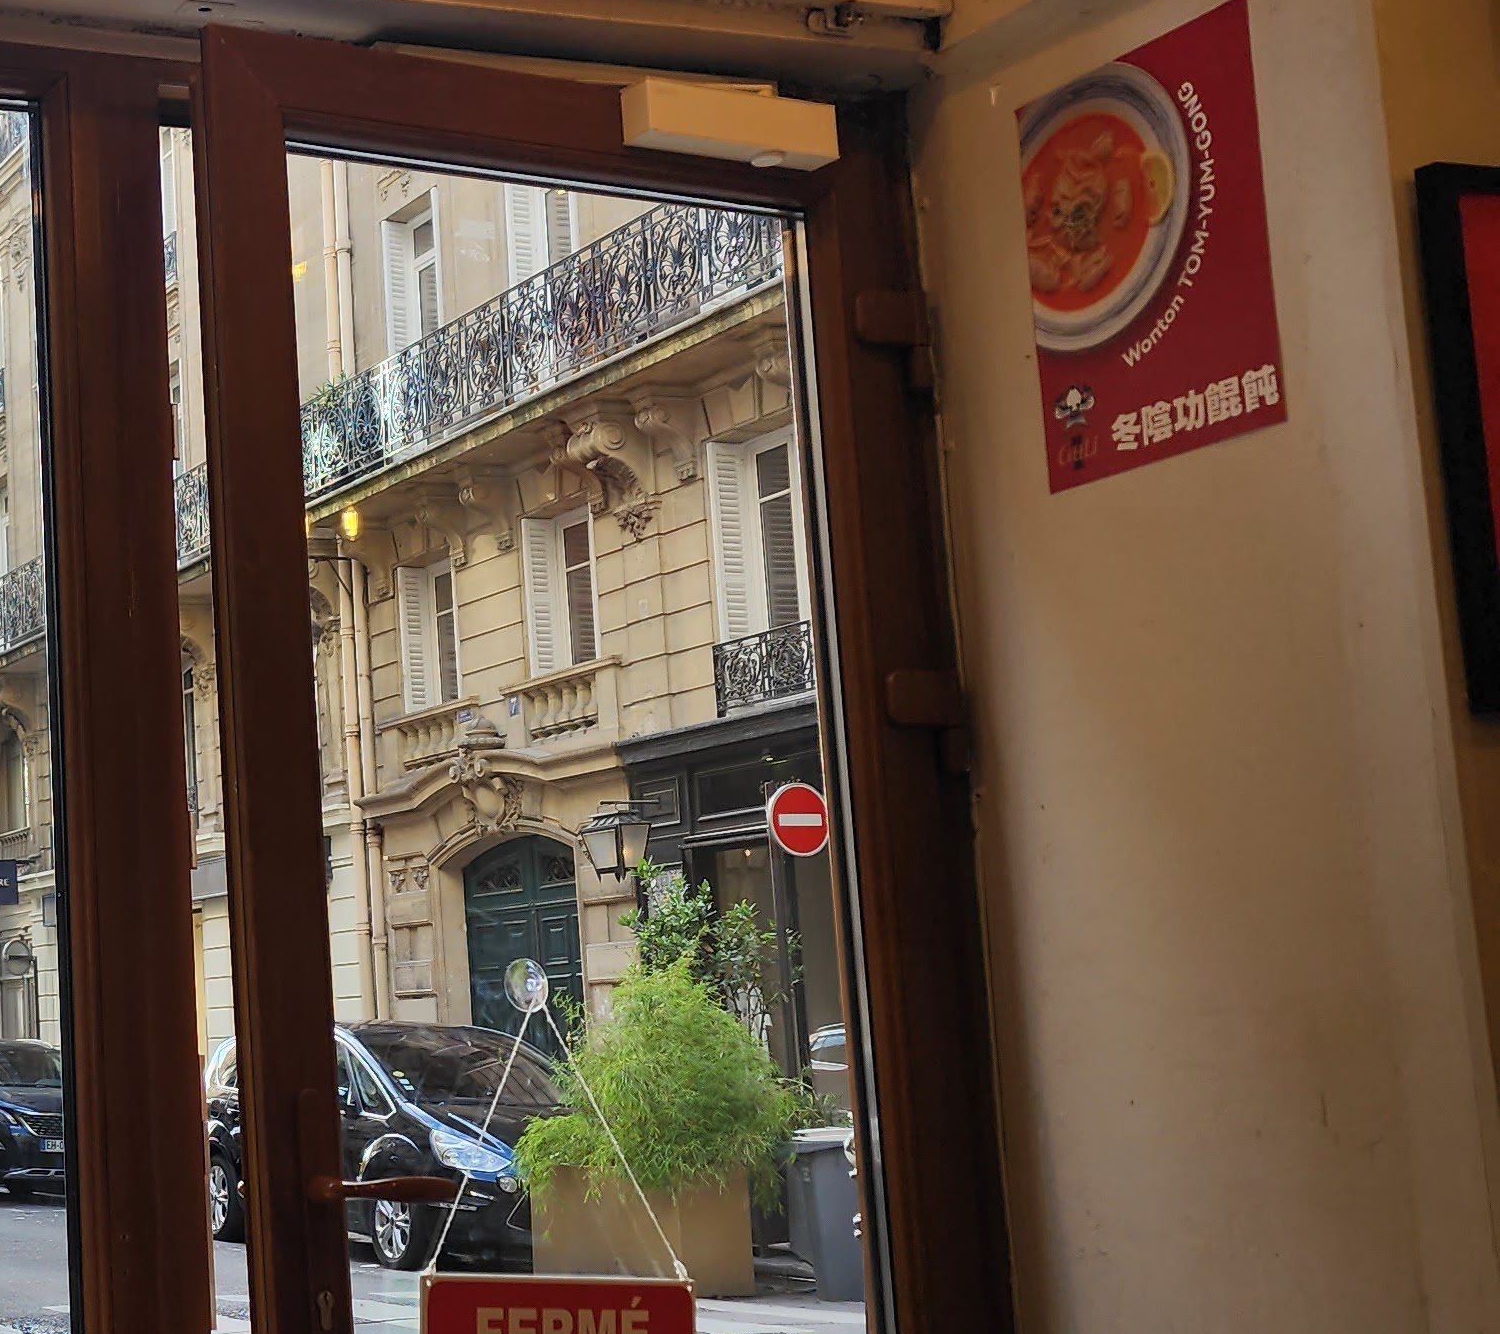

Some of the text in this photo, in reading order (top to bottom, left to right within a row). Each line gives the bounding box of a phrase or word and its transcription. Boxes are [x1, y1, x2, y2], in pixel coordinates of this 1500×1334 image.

[1121, 80, 1216, 368] Wonton TOM-YUM-GONG
[1110, 363, 1281, 452] 冬陰功餛飩
